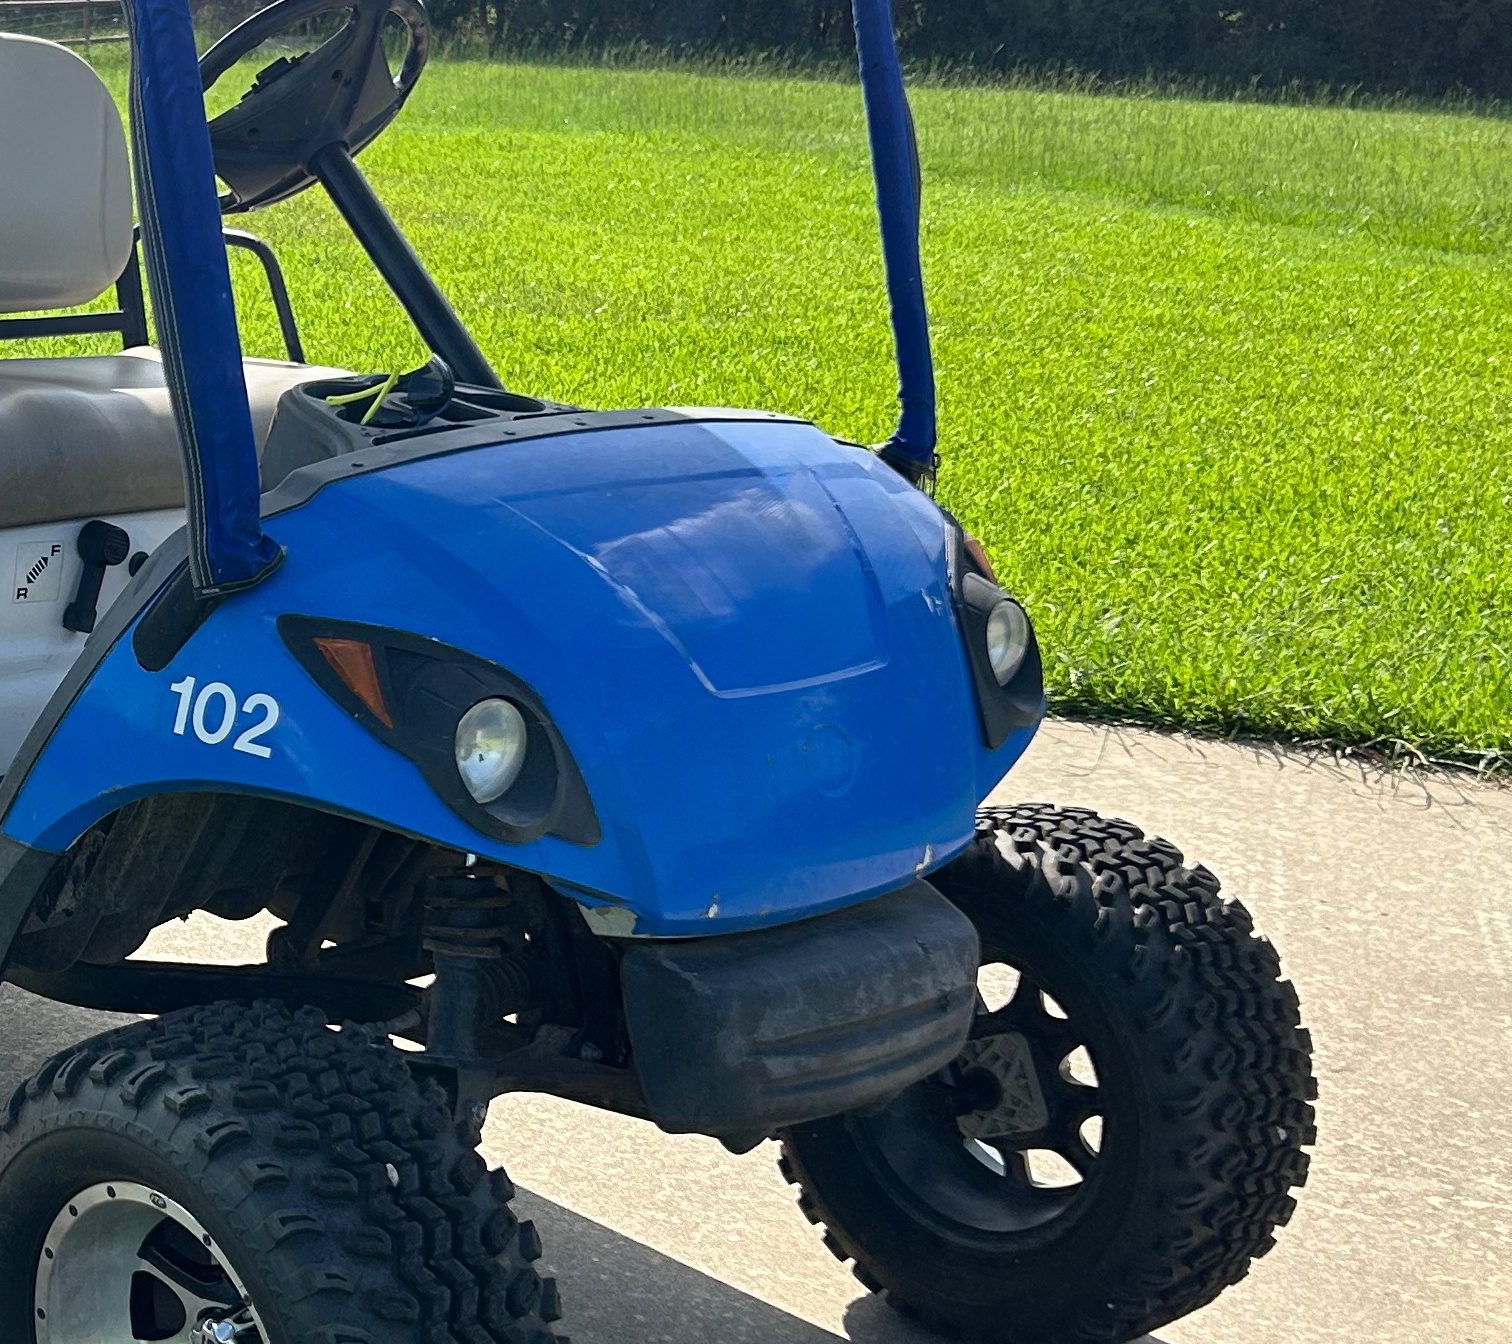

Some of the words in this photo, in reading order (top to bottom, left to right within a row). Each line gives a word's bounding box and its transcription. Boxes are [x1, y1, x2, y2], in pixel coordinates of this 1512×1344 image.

[50, 544, 62, 557] F
[16, 587, 28, 600] R
[170, 675, 280, 759] 102
